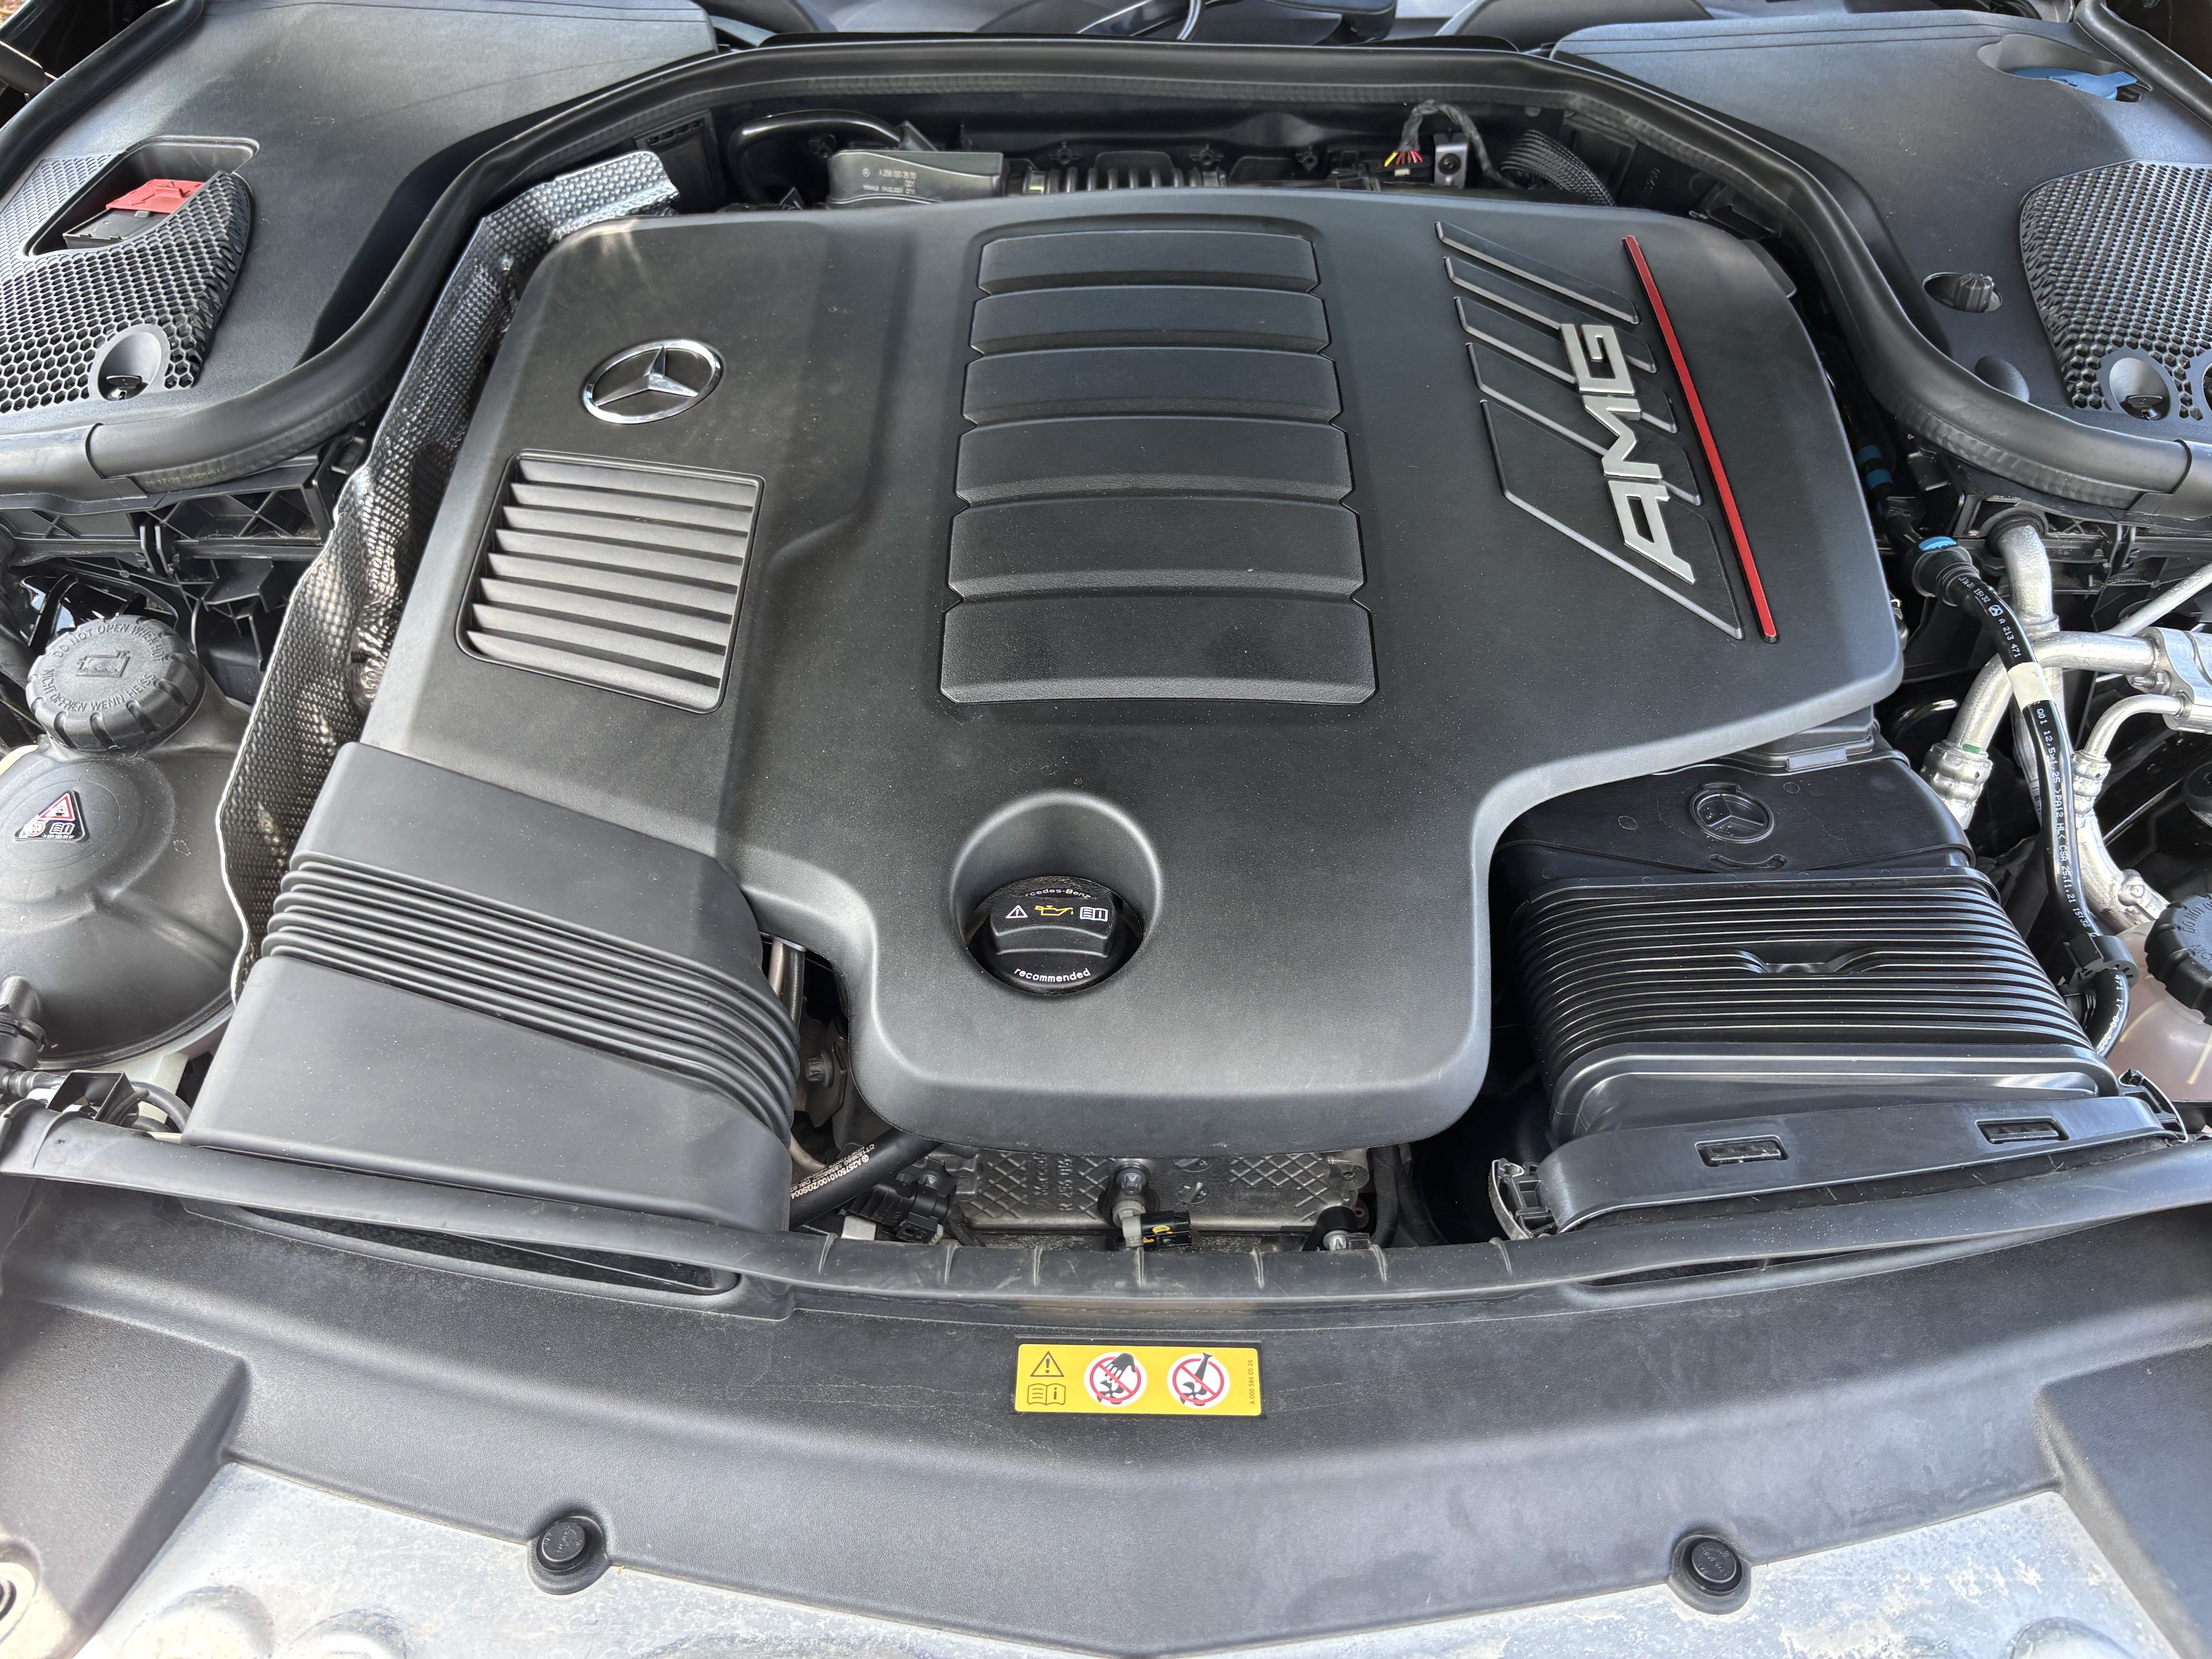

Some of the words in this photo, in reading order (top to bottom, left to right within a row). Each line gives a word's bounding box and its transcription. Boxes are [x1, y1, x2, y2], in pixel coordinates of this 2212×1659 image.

[1560, 324, 1695, 584] AMG
[53, 644, 69, 658] DO
[71, 629, 92, 646] NOT
[98, 624, 129, 634] OPEN
[131, 625, 160, 646] WHEN
[2002, 626, 2014, 641] 213
[2011, 644, 2021, 658] 471
[42, 668, 58, 693] NICHT
[90, 697, 125, 712] WENN
[124, 673, 156, 699] HEISS
[2036, 708, 2048, 725] Q01
[2059, 845, 2067, 862] CSA
[2182, 921, 2196, 934] DO
[2184, 907, 2205, 921] NOT
[1014, 968, 1091, 982] recommended
